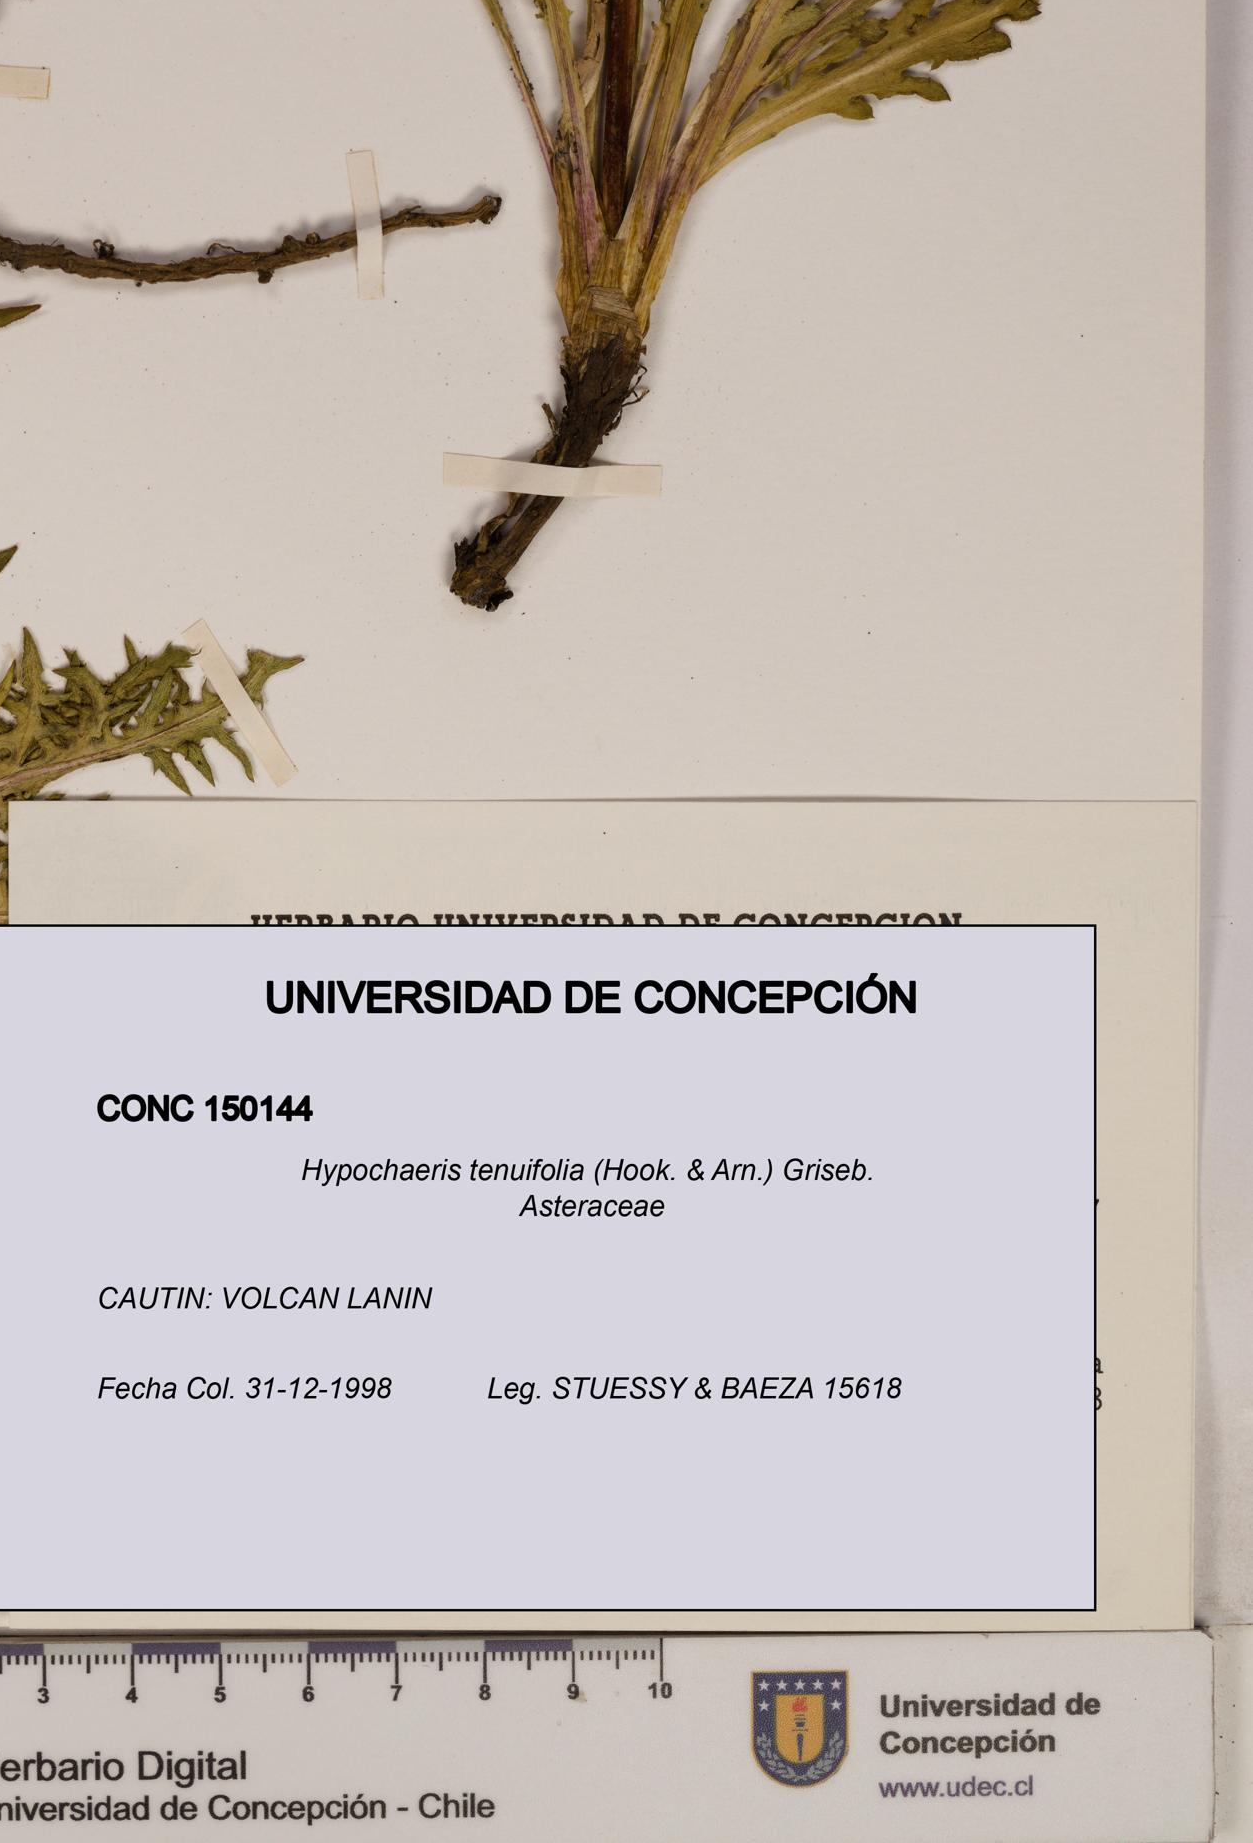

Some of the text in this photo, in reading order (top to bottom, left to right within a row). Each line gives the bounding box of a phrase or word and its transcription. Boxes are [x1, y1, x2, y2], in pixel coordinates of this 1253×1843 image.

[37, 1686, 50, 1705] 3
[124, 1686, 139, 1704] 4
[213, 1685, 227, 1704] 5
[301, 1685, 315, 1703] 6
[390, 1684, 403, 1702] 7
[478, 1684, 492, 1701] 8
[566, 1683, 580, 1701] 9
[647, 1682, 673, 1699] 10
[880, 1691, 1101, 1719] Universidad de
[879, 1728, 1056, 1760] Concepción
[137, 1749, 247, 1789] Digital
[878, 1774, 1034, 1798] www.udec.cl
[159, 1794, 199, 1821] de
[207, 1793, 387, 1827] Concepción
[418, 1792, 496, 1819] Chile
